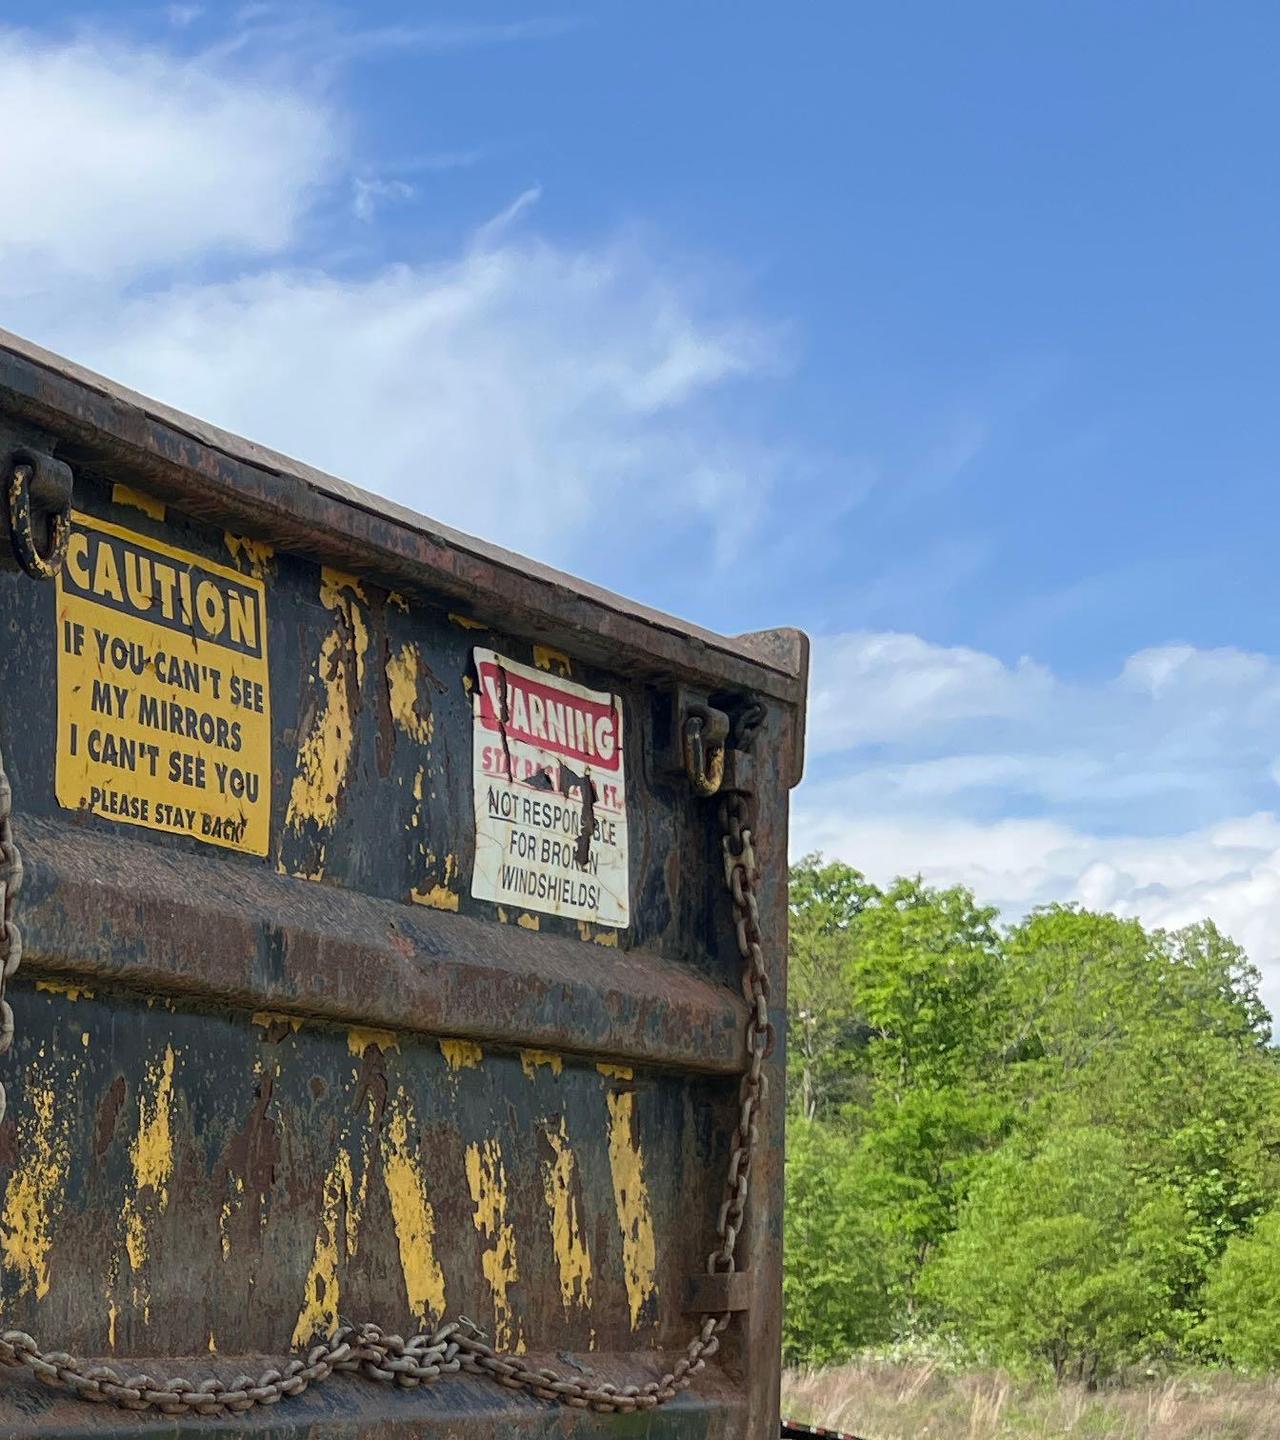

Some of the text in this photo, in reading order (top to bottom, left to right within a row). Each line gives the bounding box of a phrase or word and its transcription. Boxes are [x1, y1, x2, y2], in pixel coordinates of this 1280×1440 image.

[66, 532, 256, 648] CAUTION
[64, 620, 264, 714] IF YOU CAN'T SEE
[91, 679, 241, 752] MY MIRRORS
[484, 676, 614, 760] WARNING
[70, 723, 259, 803] I CAN'T SEE YOU
[91, 787, 149, 821] PLEASE
[155, 803, 196, 830] STAY
[488, 785, 616, 846] NOT RESPONBLE
[510, 830, 536, 860] FOR
[501, 863, 601, 911] WINDSHIELDS!
